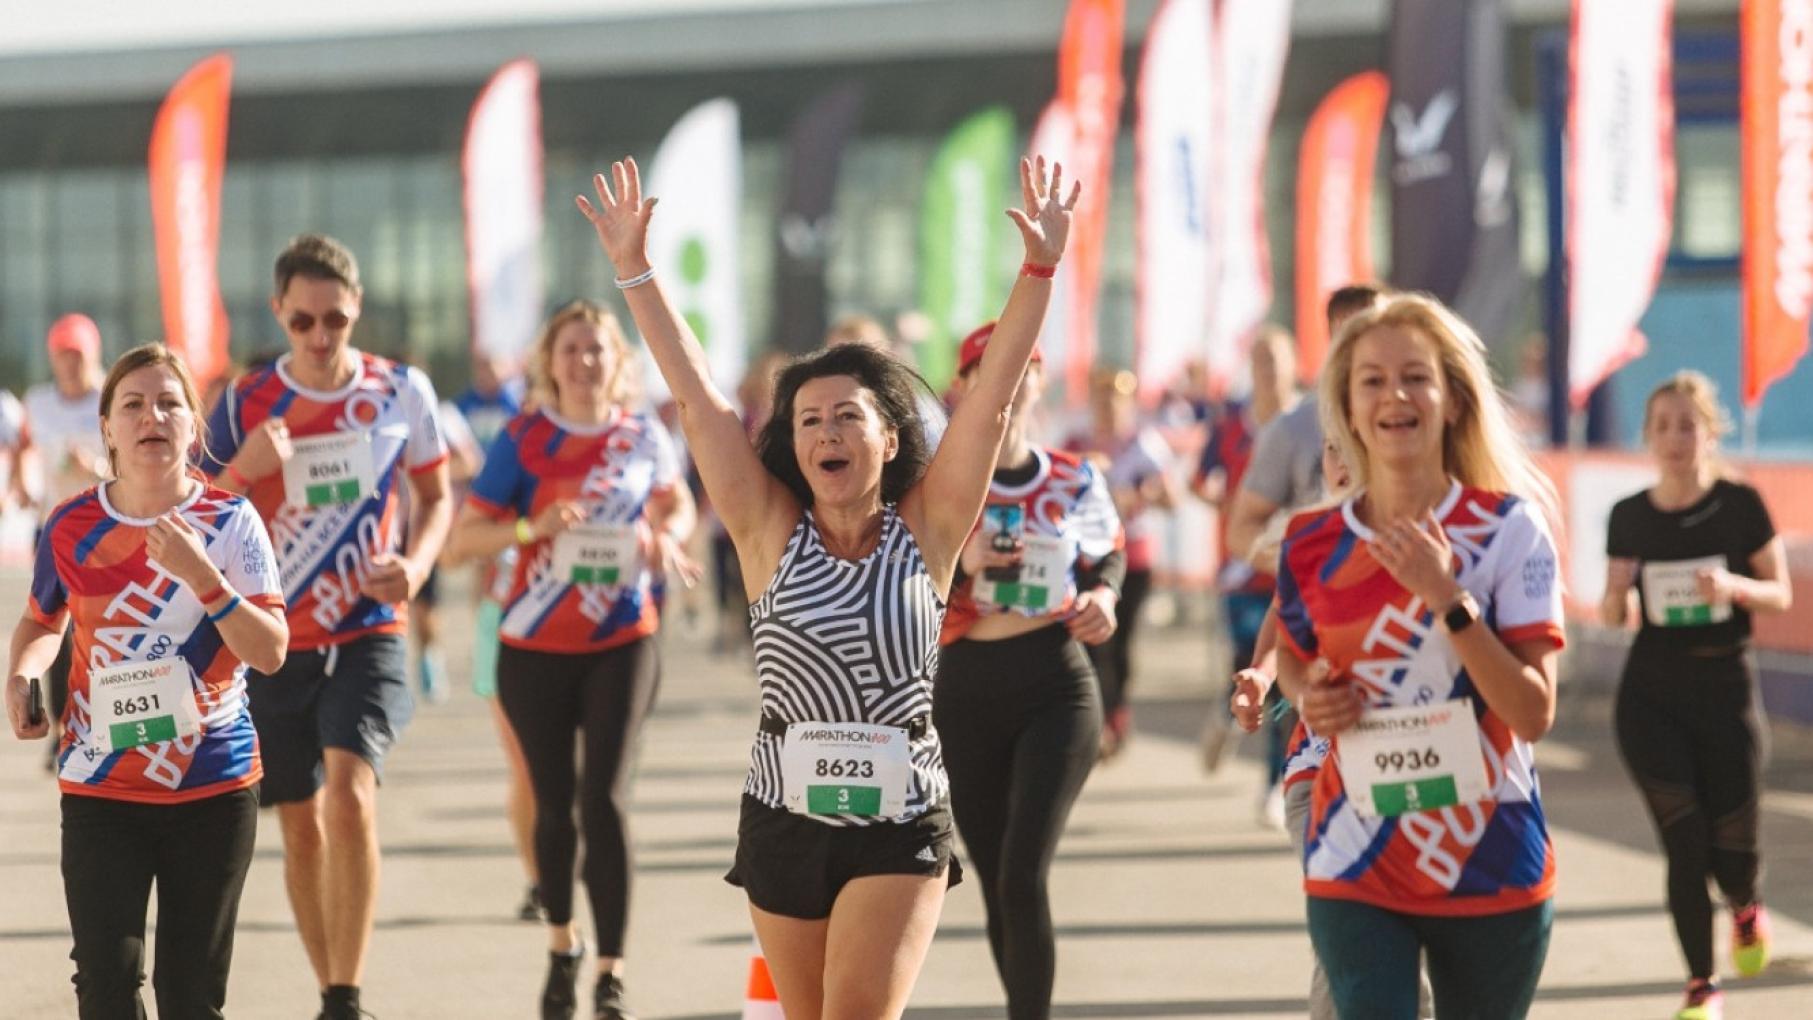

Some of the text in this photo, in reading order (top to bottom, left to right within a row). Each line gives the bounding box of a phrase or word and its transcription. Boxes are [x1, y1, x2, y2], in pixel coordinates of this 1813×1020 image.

[113, 694, 160, 716] 8631
[136, 722, 147, 736] 3
[815, 758, 874, 778] 8623
[1374, 746, 1440, 774] 9936
[838, 788, 849, 802] 3
